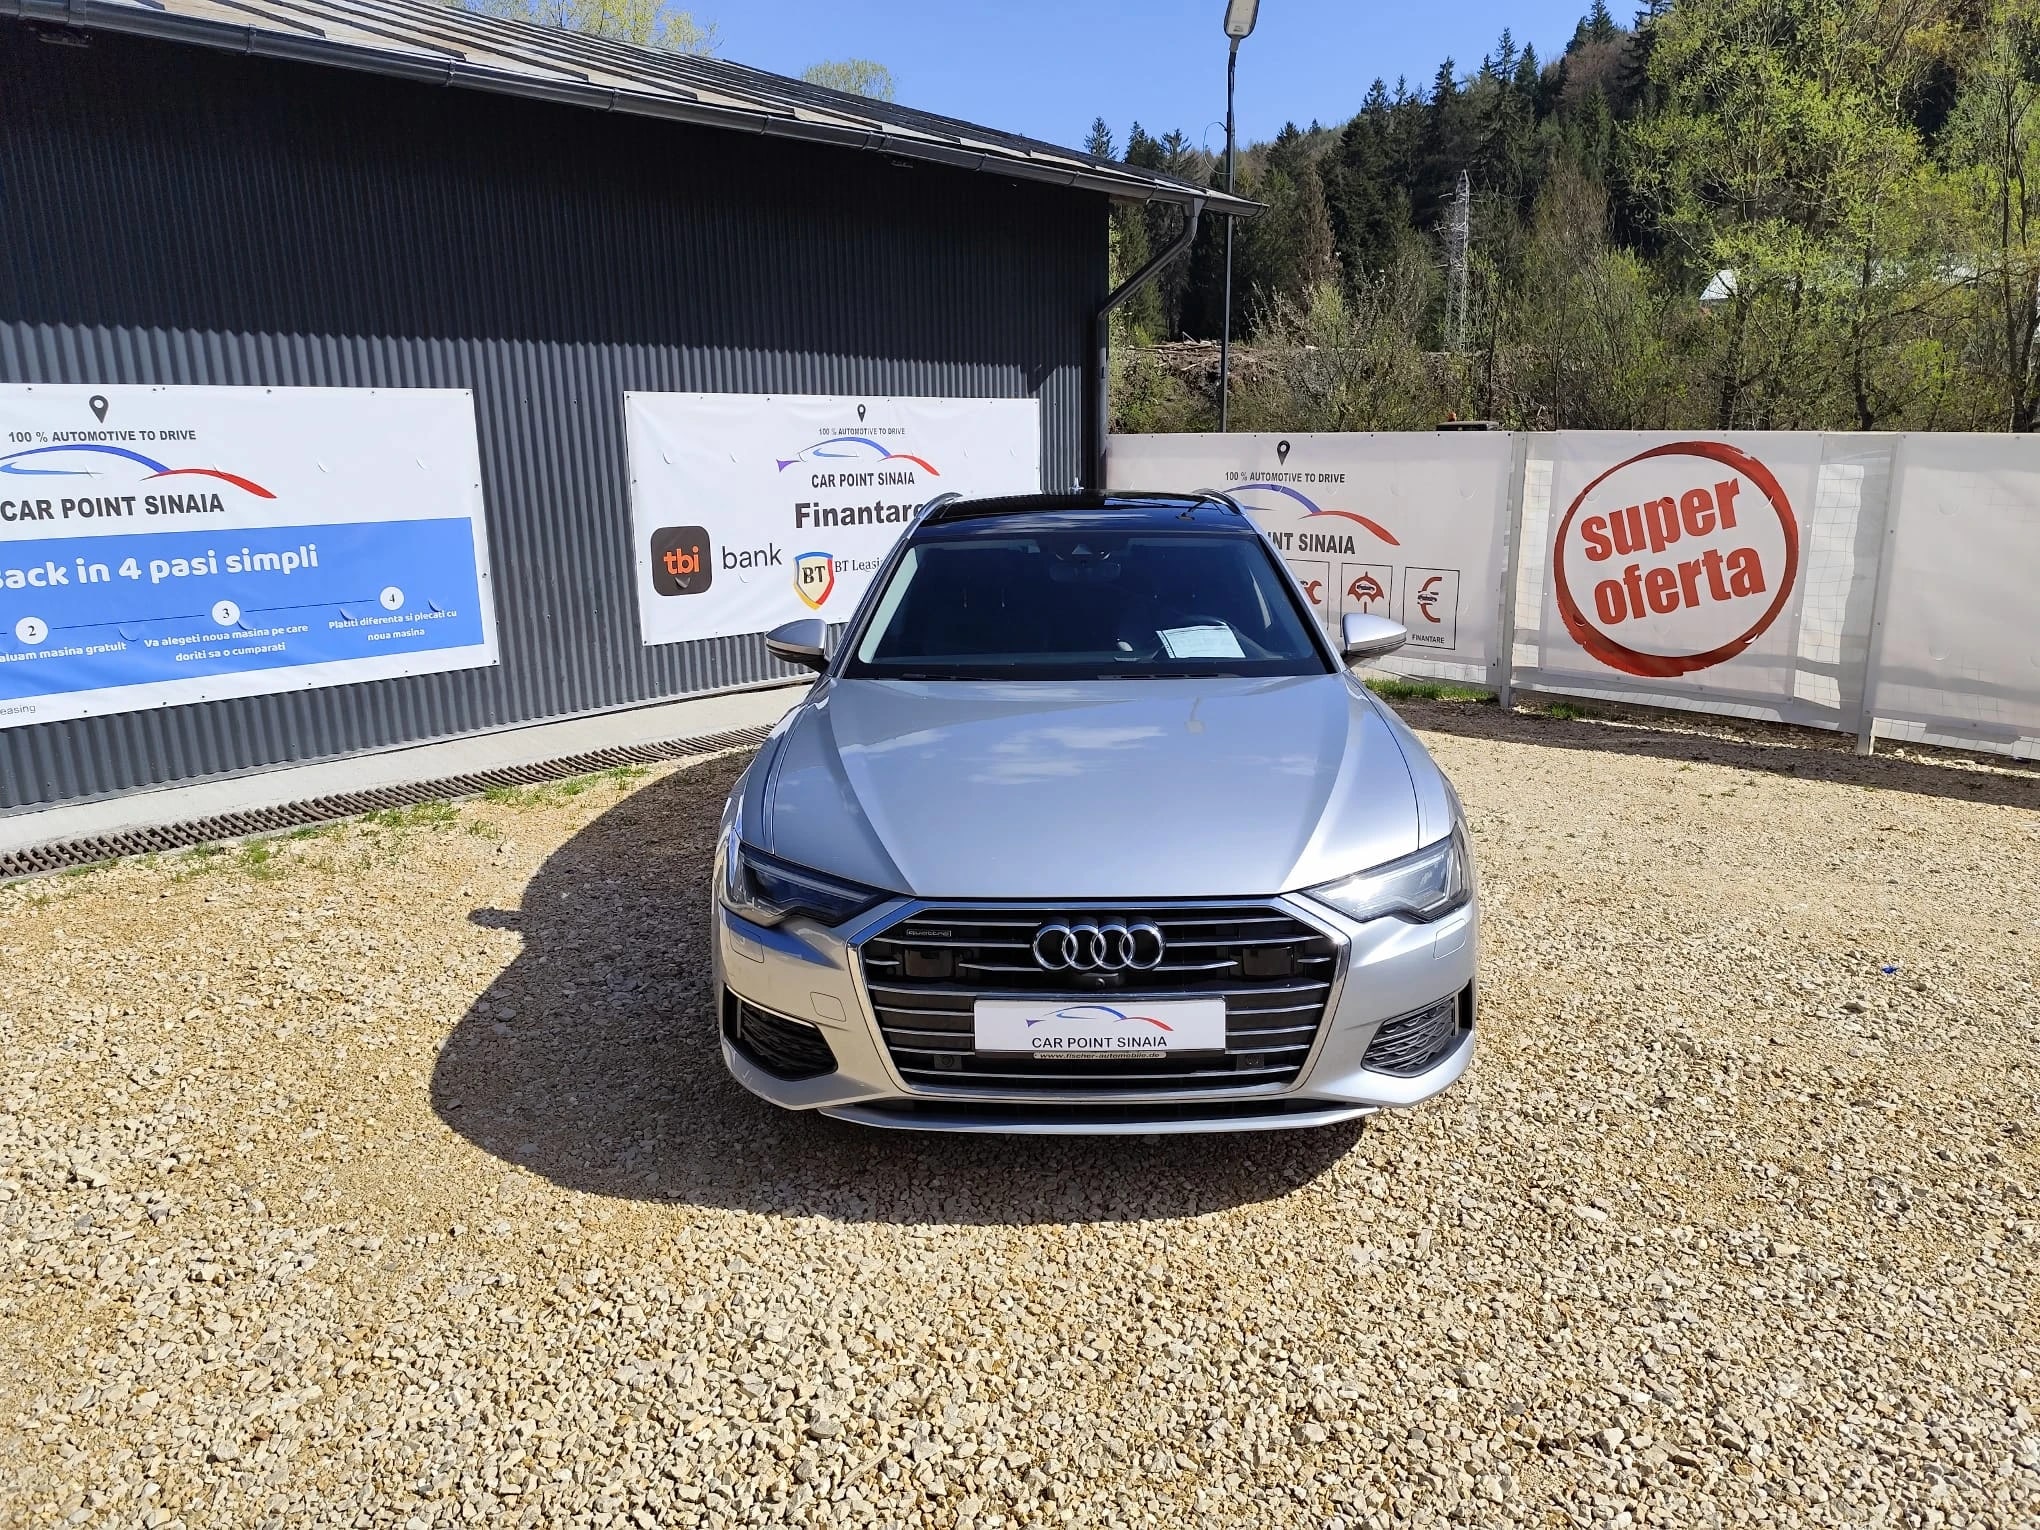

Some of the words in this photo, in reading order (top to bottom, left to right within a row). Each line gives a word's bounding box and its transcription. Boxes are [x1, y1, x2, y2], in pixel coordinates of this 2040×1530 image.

[8, 431, 32, 443] 100
[36, 431, 48, 443] %
[52, 431, 137, 442] AUTOMOTIVE
[139, 430, 156, 441] TO
[159, 430, 197, 441] DRIVE
[811, 474, 836, 488] CAR
[839, 473, 874, 487] POINT
[878, 472, 915, 486] SINAIA
[1225, 472, 1239, 481] 100
[1249, 472, 1302, 482] AUTOMOTIVE
[1305, 473, 1316, 482] TO
[1318, 473, 1346, 483] DRIVE
[0, 499, 55, 521] CAR
[61, 496, 136, 519] POINT
[145, 493, 225, 515] SINAIA
[1580, 478, 1740, 561] super
[1298, 533, 1356, 555] SINAIA
[0, 561, 70, 589] ack
[75, 558, 111, 584] in
[118, 557, 142, 580] 4
[150, 549, 219, 584] pasi
[225, 543, 319, 575] simpli
[663, 545, 700, 575] tbi
[722, 543, 783, 570] bank
[834, 560, 849, 573] BT
[802, 565, 827, 585] BT
[1594, 547, 1767, 625] oferta
[389, 593, 396, 603] 4
[223, 608, 230, 619] 3
[359, 615, 403, 627] diferenta
[405, 612, 413, 622] si
[414, 609, 445, 623] plecati
[447, 609, 457, 618] cu
[27, 625, 37, 637] 2
[144, 639, 160, 648] Va
[161, 633, 201, 646] alegeti
[202, 631, 230, 642] noua
[232, 627, 269, 640] masina
[271, 626, 285, 637] pe
[286, 624, 309, 634] care
[367, 632, 392, 642] noua
[392, 627, 425, 639] masina
[1411, 633, 1446, 644] FINANTARE
[39, 645, 84, 660] masina
[175, 649, 207, 662] doriti
[208, 649, 222, 659] sa
[223, 649, 231, 657] o
[232, 641, 287, 657] cumparati
[1031, 1037, 1063, 1049] CAR
[1067, 1037, 1113, 1048] POINT
[1117, 1036, 1168, 1048] SINAIA
